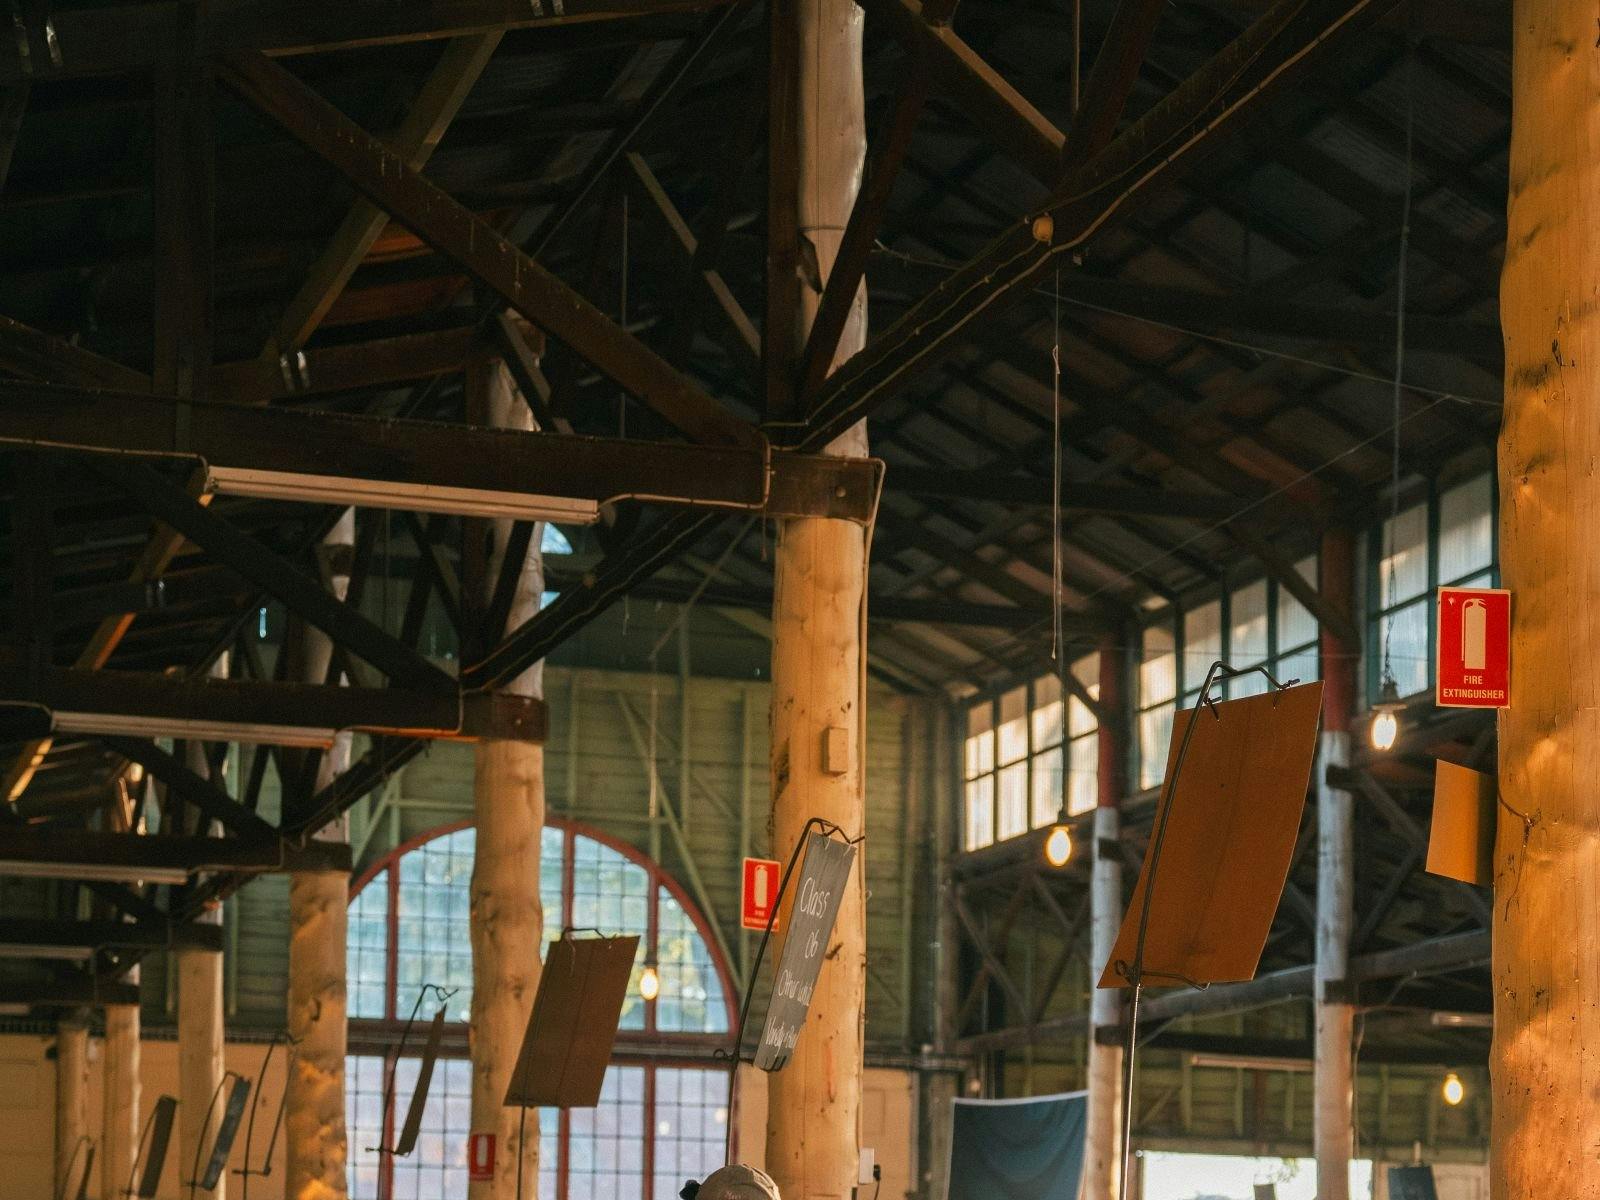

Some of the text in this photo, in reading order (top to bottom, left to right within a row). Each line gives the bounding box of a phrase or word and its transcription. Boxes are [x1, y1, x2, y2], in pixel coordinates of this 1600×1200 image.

[1463, 675, 1483, 685] FIRE
[1443, 688, 1505, 699] EXTINGUISHER
[800, 876, 831, 919] Class
